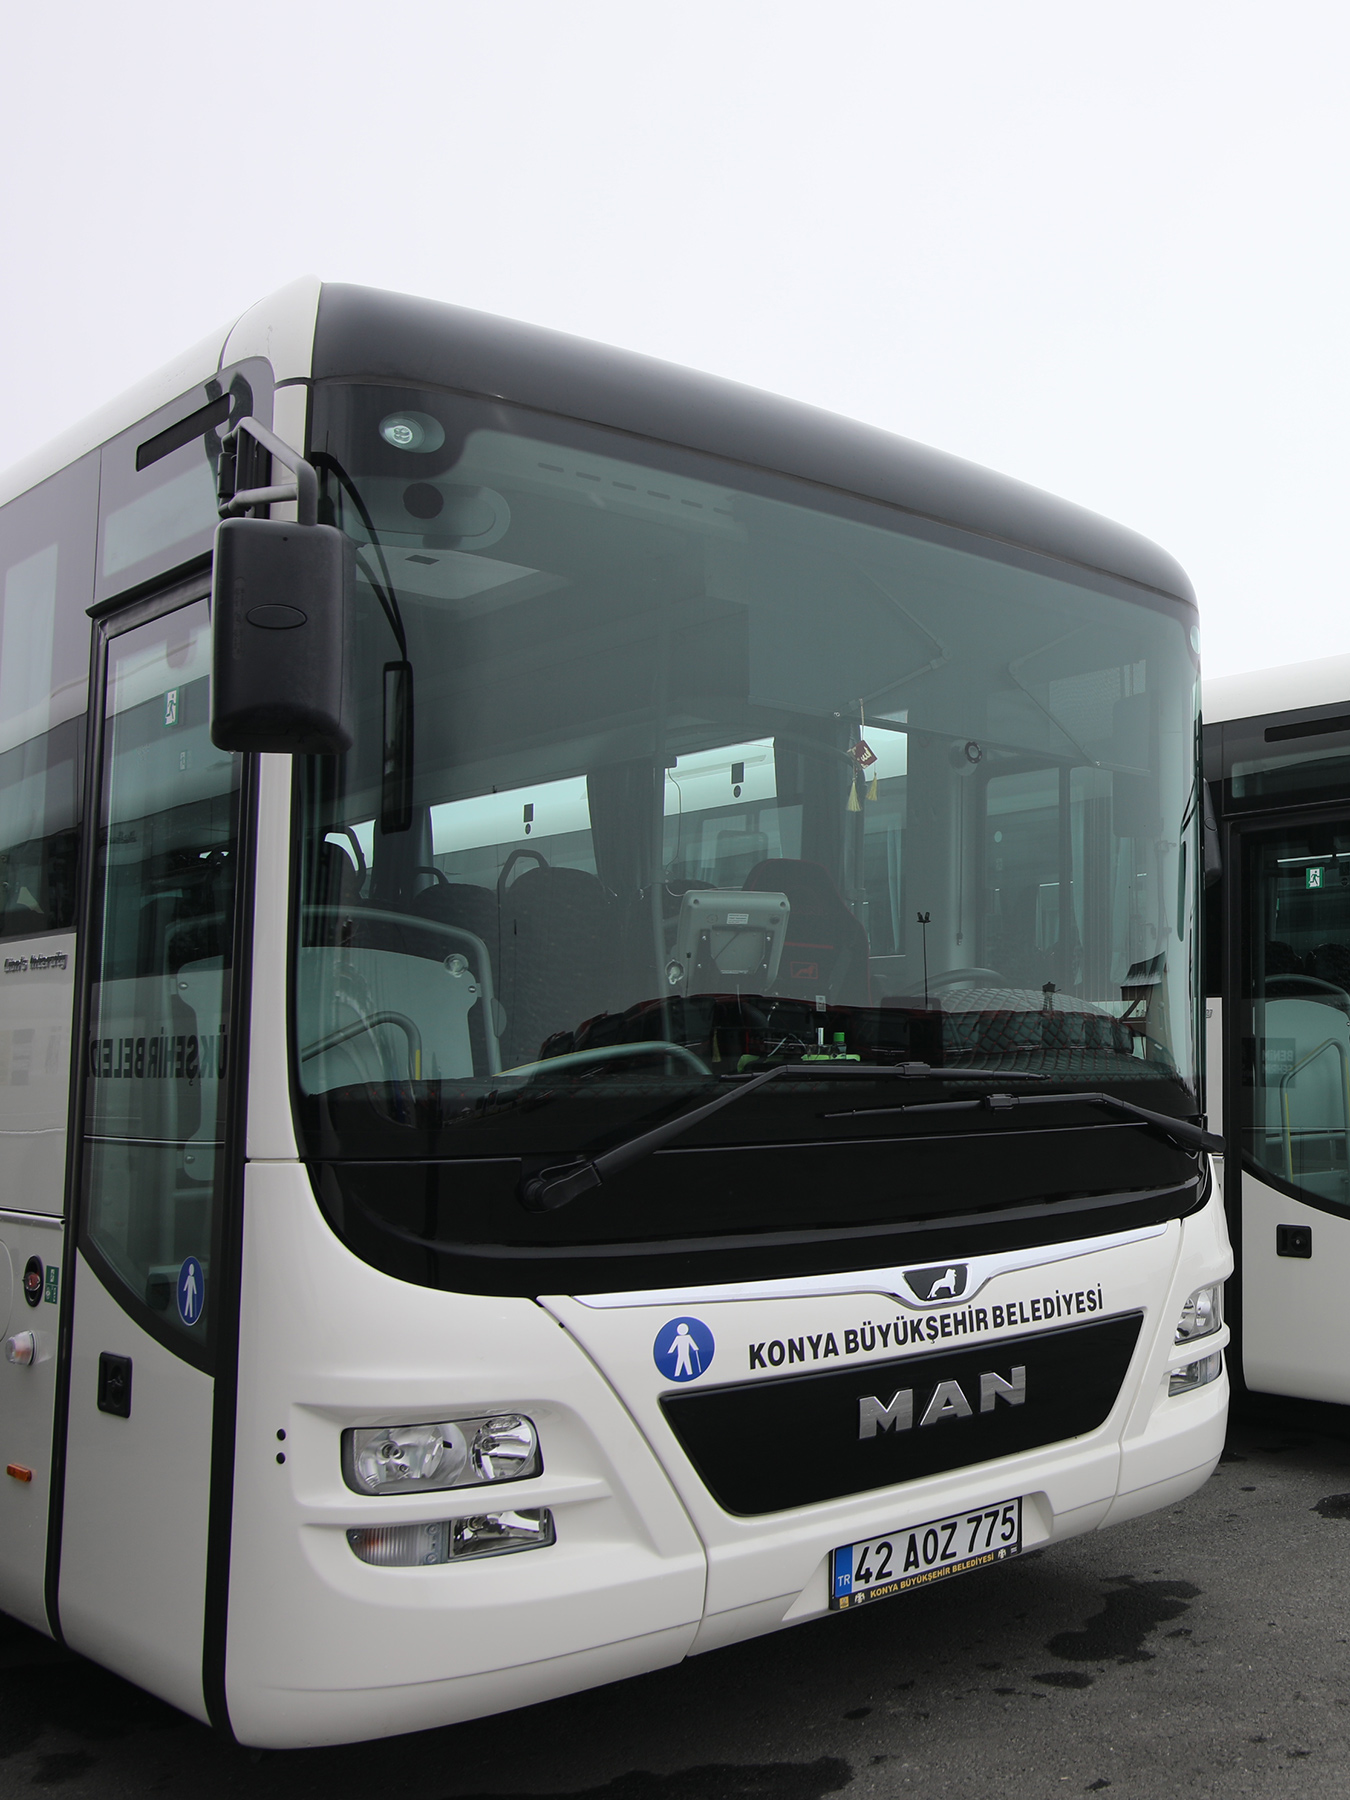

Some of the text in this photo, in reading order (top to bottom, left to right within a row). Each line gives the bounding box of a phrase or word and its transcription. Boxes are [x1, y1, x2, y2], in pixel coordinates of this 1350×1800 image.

[749, 1282, 1105, 1370] KONYA BÜYÜKŞEHİR BELEDİYESİ
[857, 1364, 1027, 1440] MAN
[838, 1573, 851, 1587] TR
[854, 1505, 1015, 1584] 42 AOZ 775
[870, 1552, 995, 1598] KONYA BÜYÜKŞEHİR BELEDİYESİ
